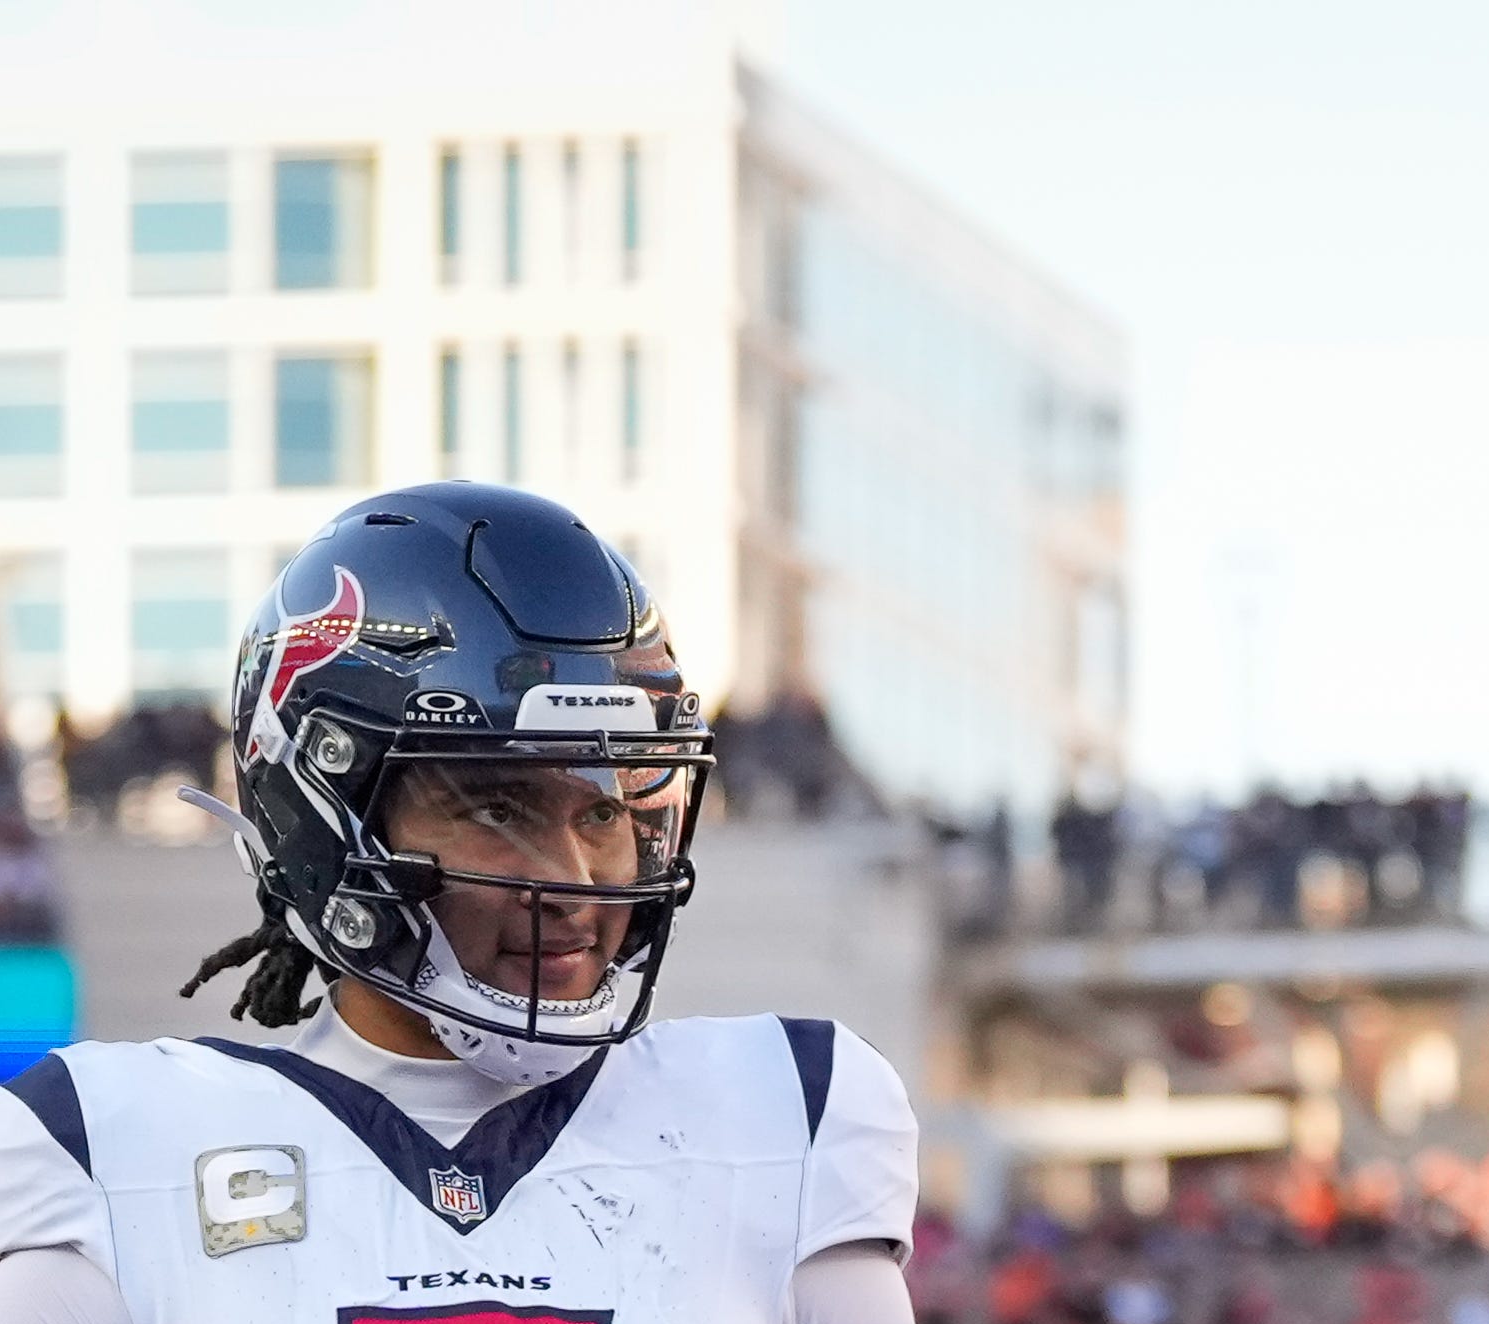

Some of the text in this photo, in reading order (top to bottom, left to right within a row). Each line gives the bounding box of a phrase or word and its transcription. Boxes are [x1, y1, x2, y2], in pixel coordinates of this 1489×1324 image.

[545, 694, 636, 708] TEXANS
[405, 710, 479, 725] OAKLEY
[202, 1149, 296, 1225] C
[442, 1186, 479, 1211] NFL
[386, 1268, 552, 1292] TEXANS
